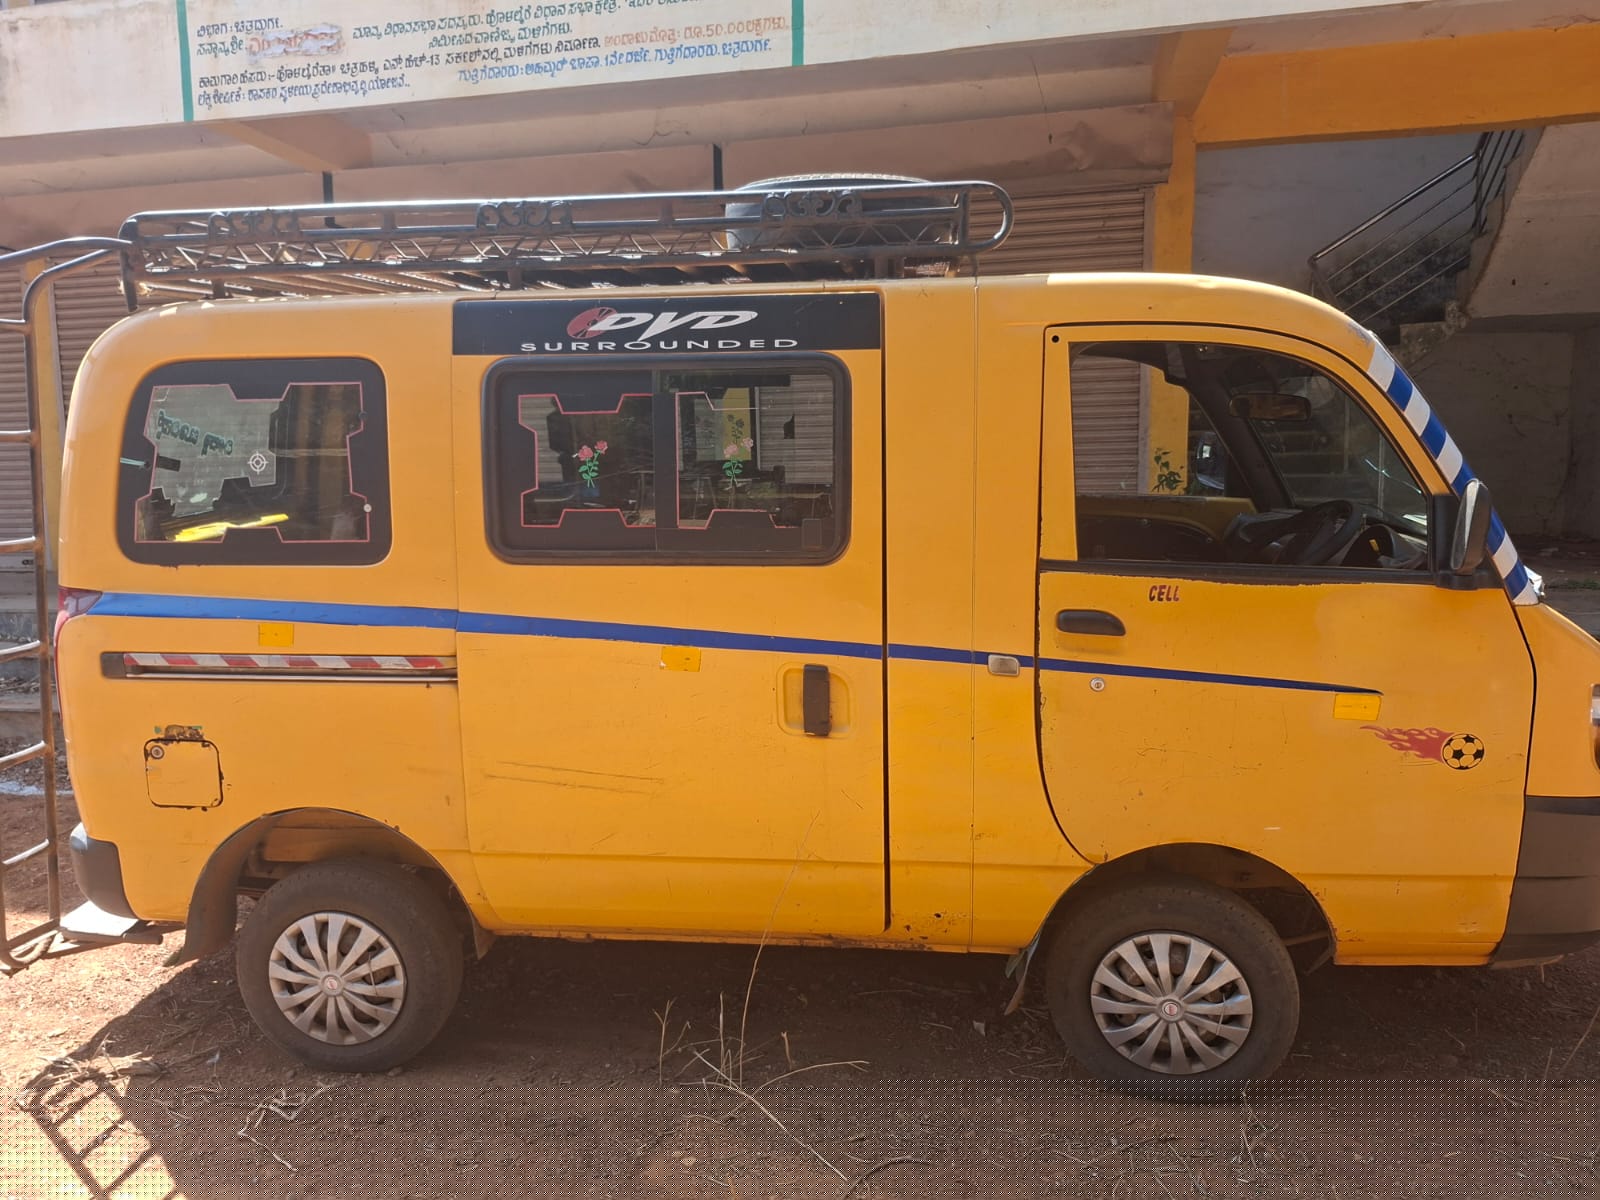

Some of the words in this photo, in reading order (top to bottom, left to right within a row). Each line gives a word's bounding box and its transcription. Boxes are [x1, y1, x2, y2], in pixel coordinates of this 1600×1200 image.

[588, 311, 758, 341] DVD
[520, 339, 798, 352] SURROUNDED
[1148, 584, 1180, 602] CELL
